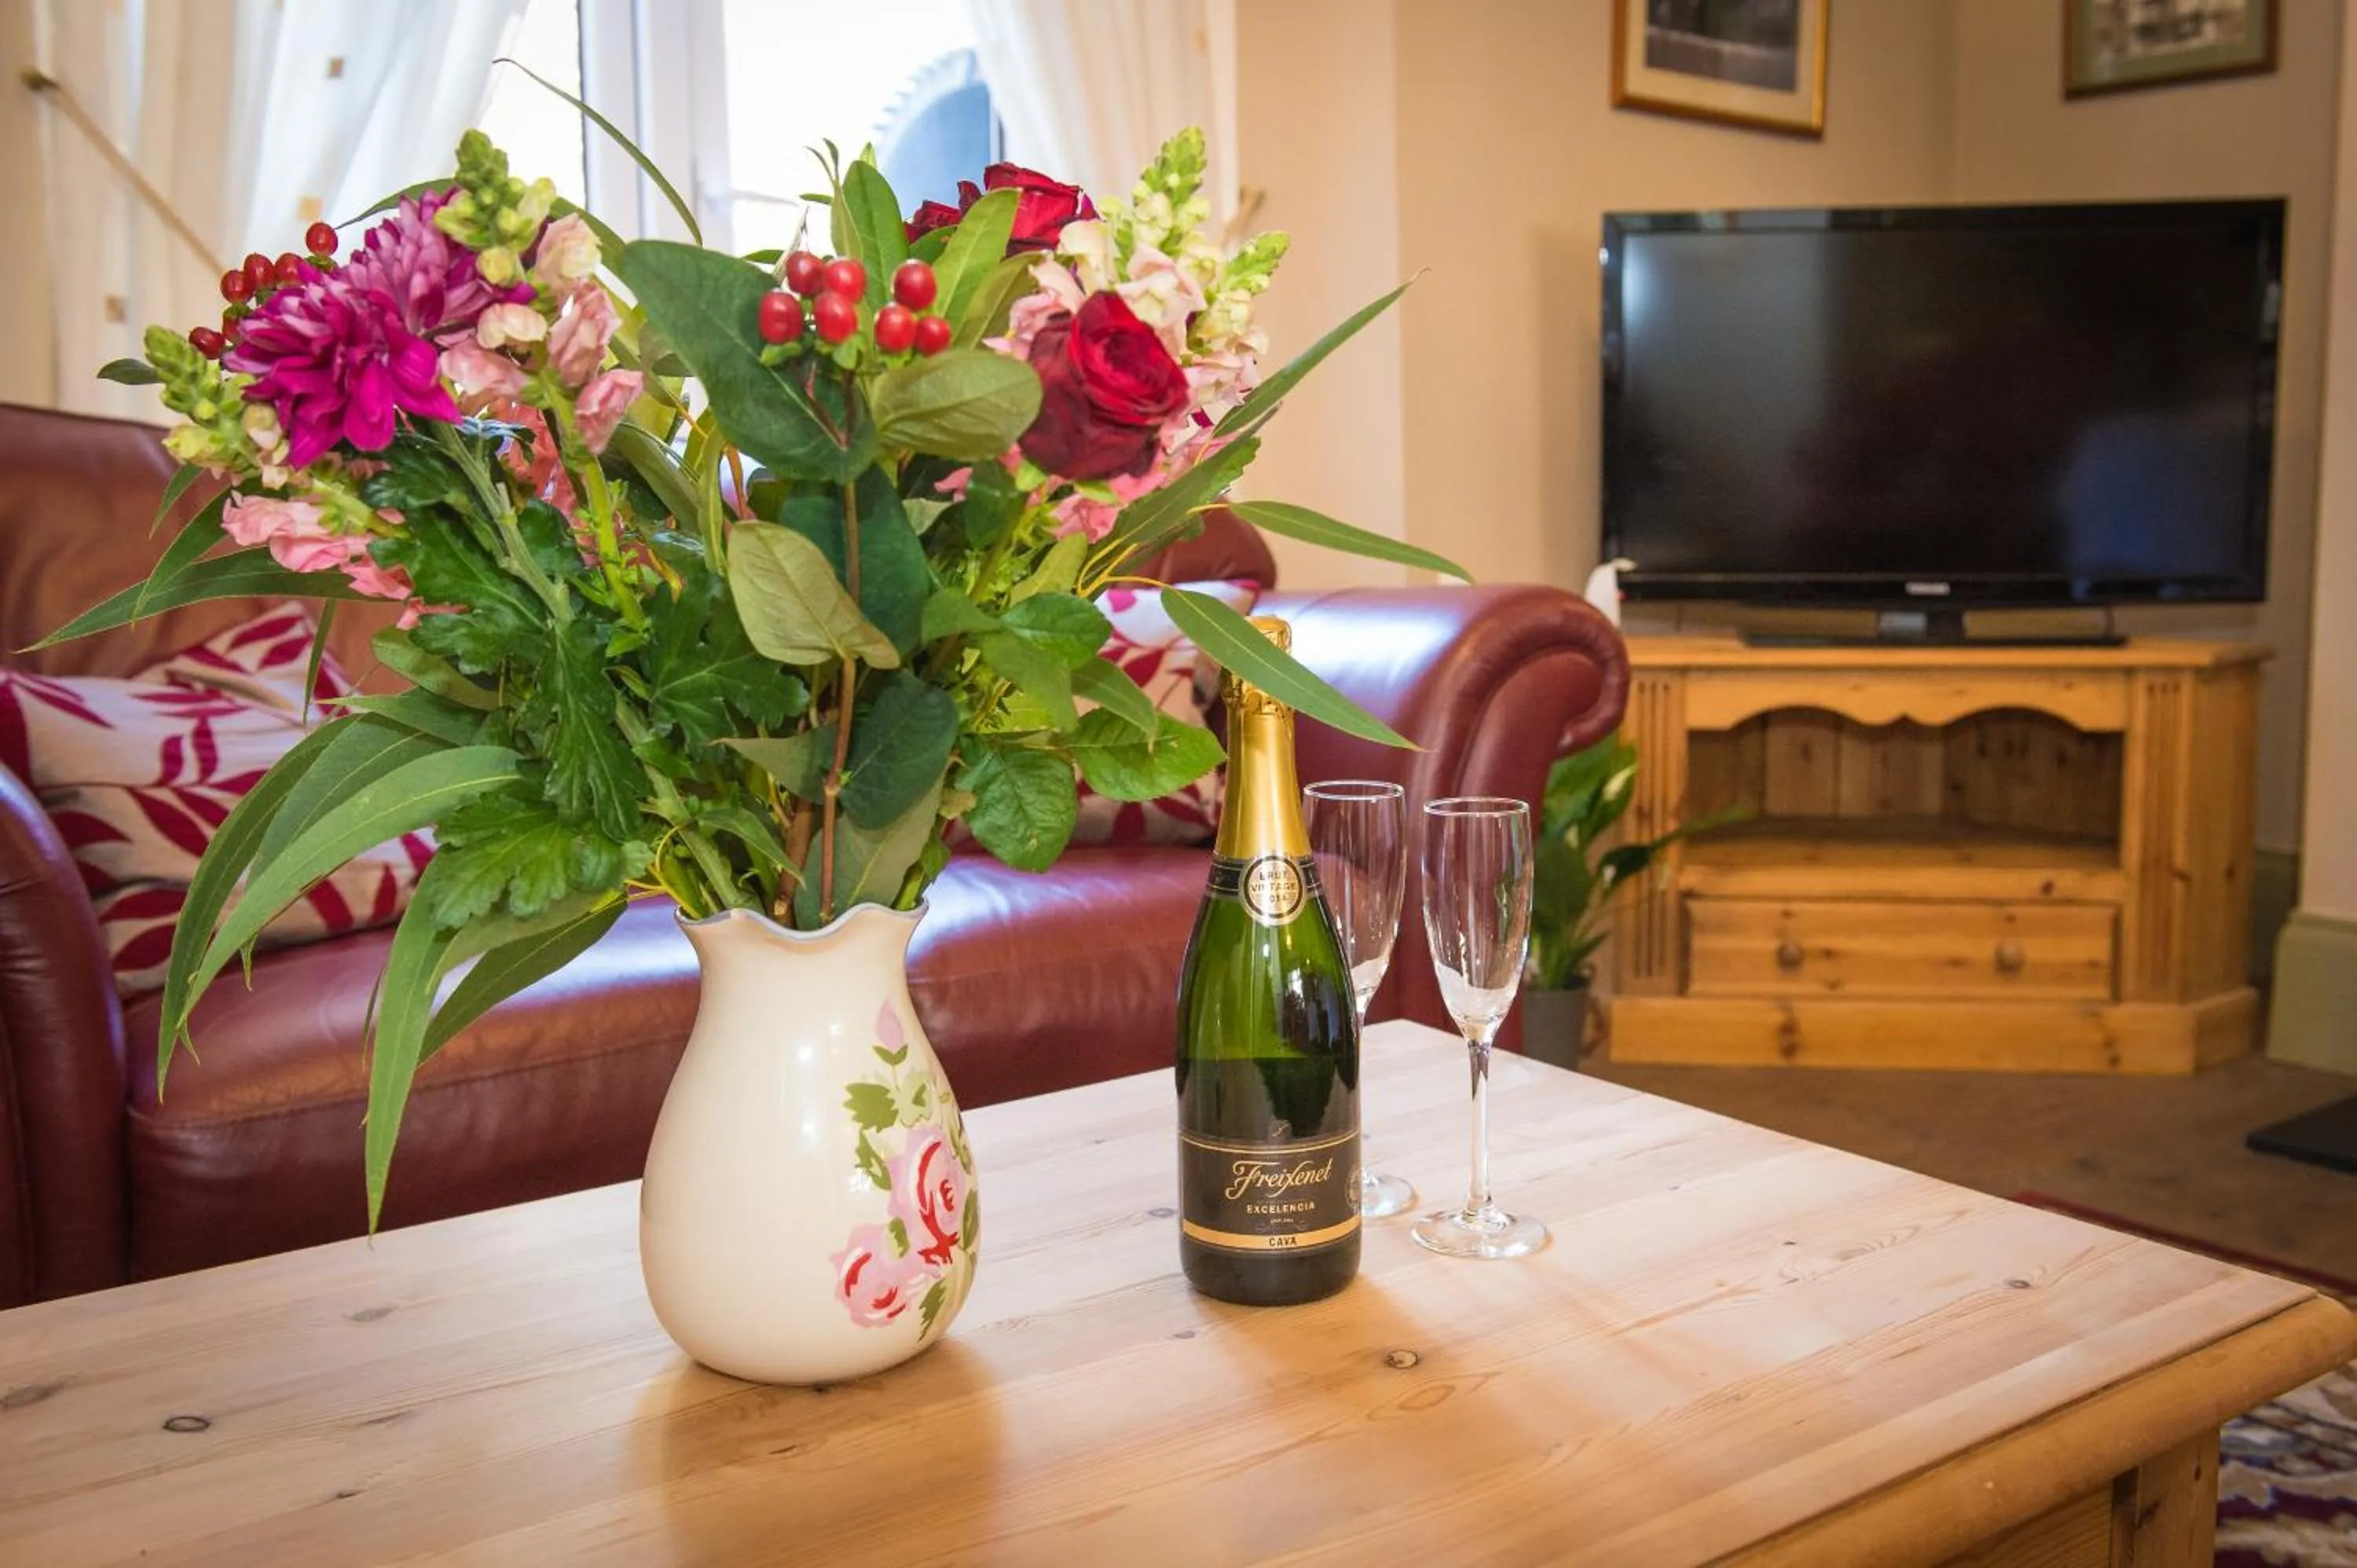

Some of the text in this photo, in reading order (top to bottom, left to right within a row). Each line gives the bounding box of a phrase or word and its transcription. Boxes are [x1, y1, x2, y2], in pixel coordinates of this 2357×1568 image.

[1225, 1158, 1333, 1200] Freixenet
[1246, 1201, 1315, 1214] EXCELENCIA
[1269, 1236, 1296, 1246] CAVA
